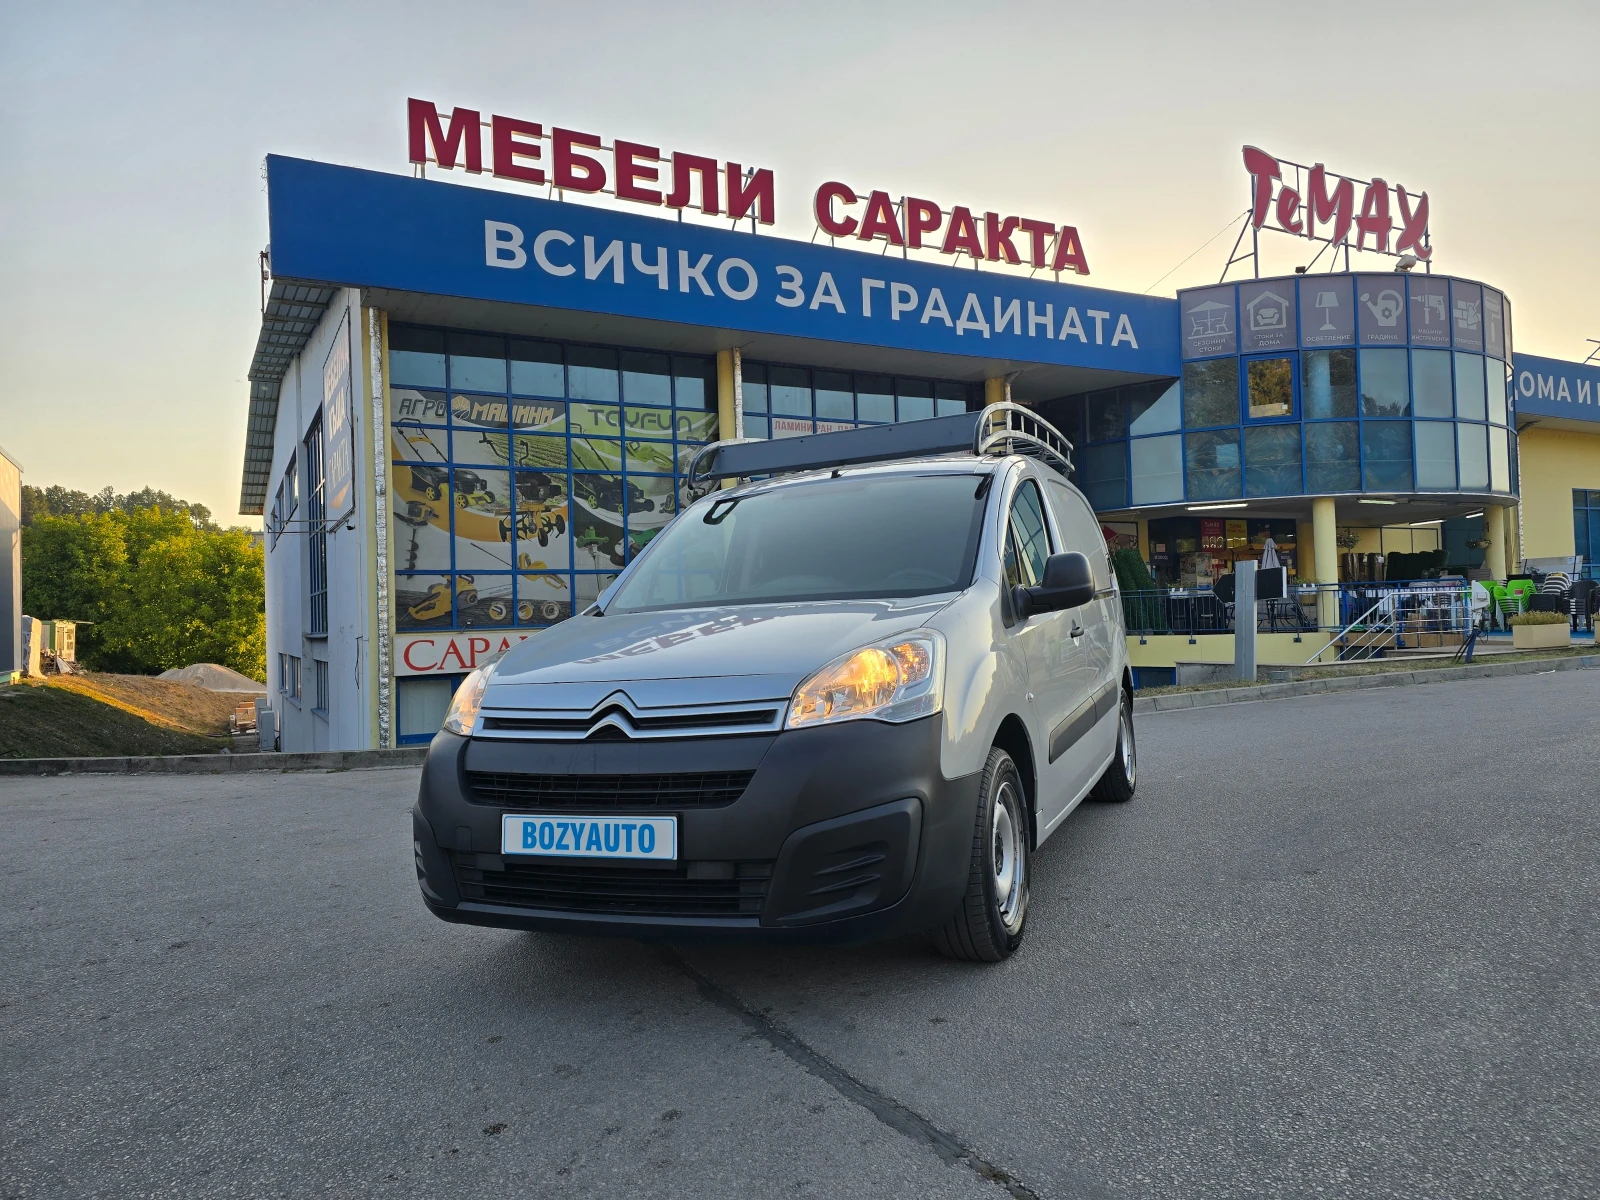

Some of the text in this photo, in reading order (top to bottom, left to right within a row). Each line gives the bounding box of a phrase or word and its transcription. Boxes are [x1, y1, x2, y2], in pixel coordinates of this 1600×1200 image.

[407, 97, 1090, 276] МЕБЕЛИ САРАКТА
[484, 219, 1139, 350] ВСИЧКО ЗА ГРАДИНАТА
[1193, 337, 1226, 347] СЕЗОННИ
[1258, 339, 1281, 347] ДОМА
[1306, 334, 1351, 342] ОСВЕТЛЕНИЕ
[1411, 334, 1450, 342] ИНСТРУМЕНТИ
[1199, 345, 1222, 353] СТОКИ
[1514, 370, 1572, 403] ОМА
[1576, 378, 1591, 405] И
[398, 398, 555, 425] АГРО МАШИНИ
[774, 420, 832, 433] ЛАМИНИРАН
[522, 821, 656, 854] BOZYAUTO
